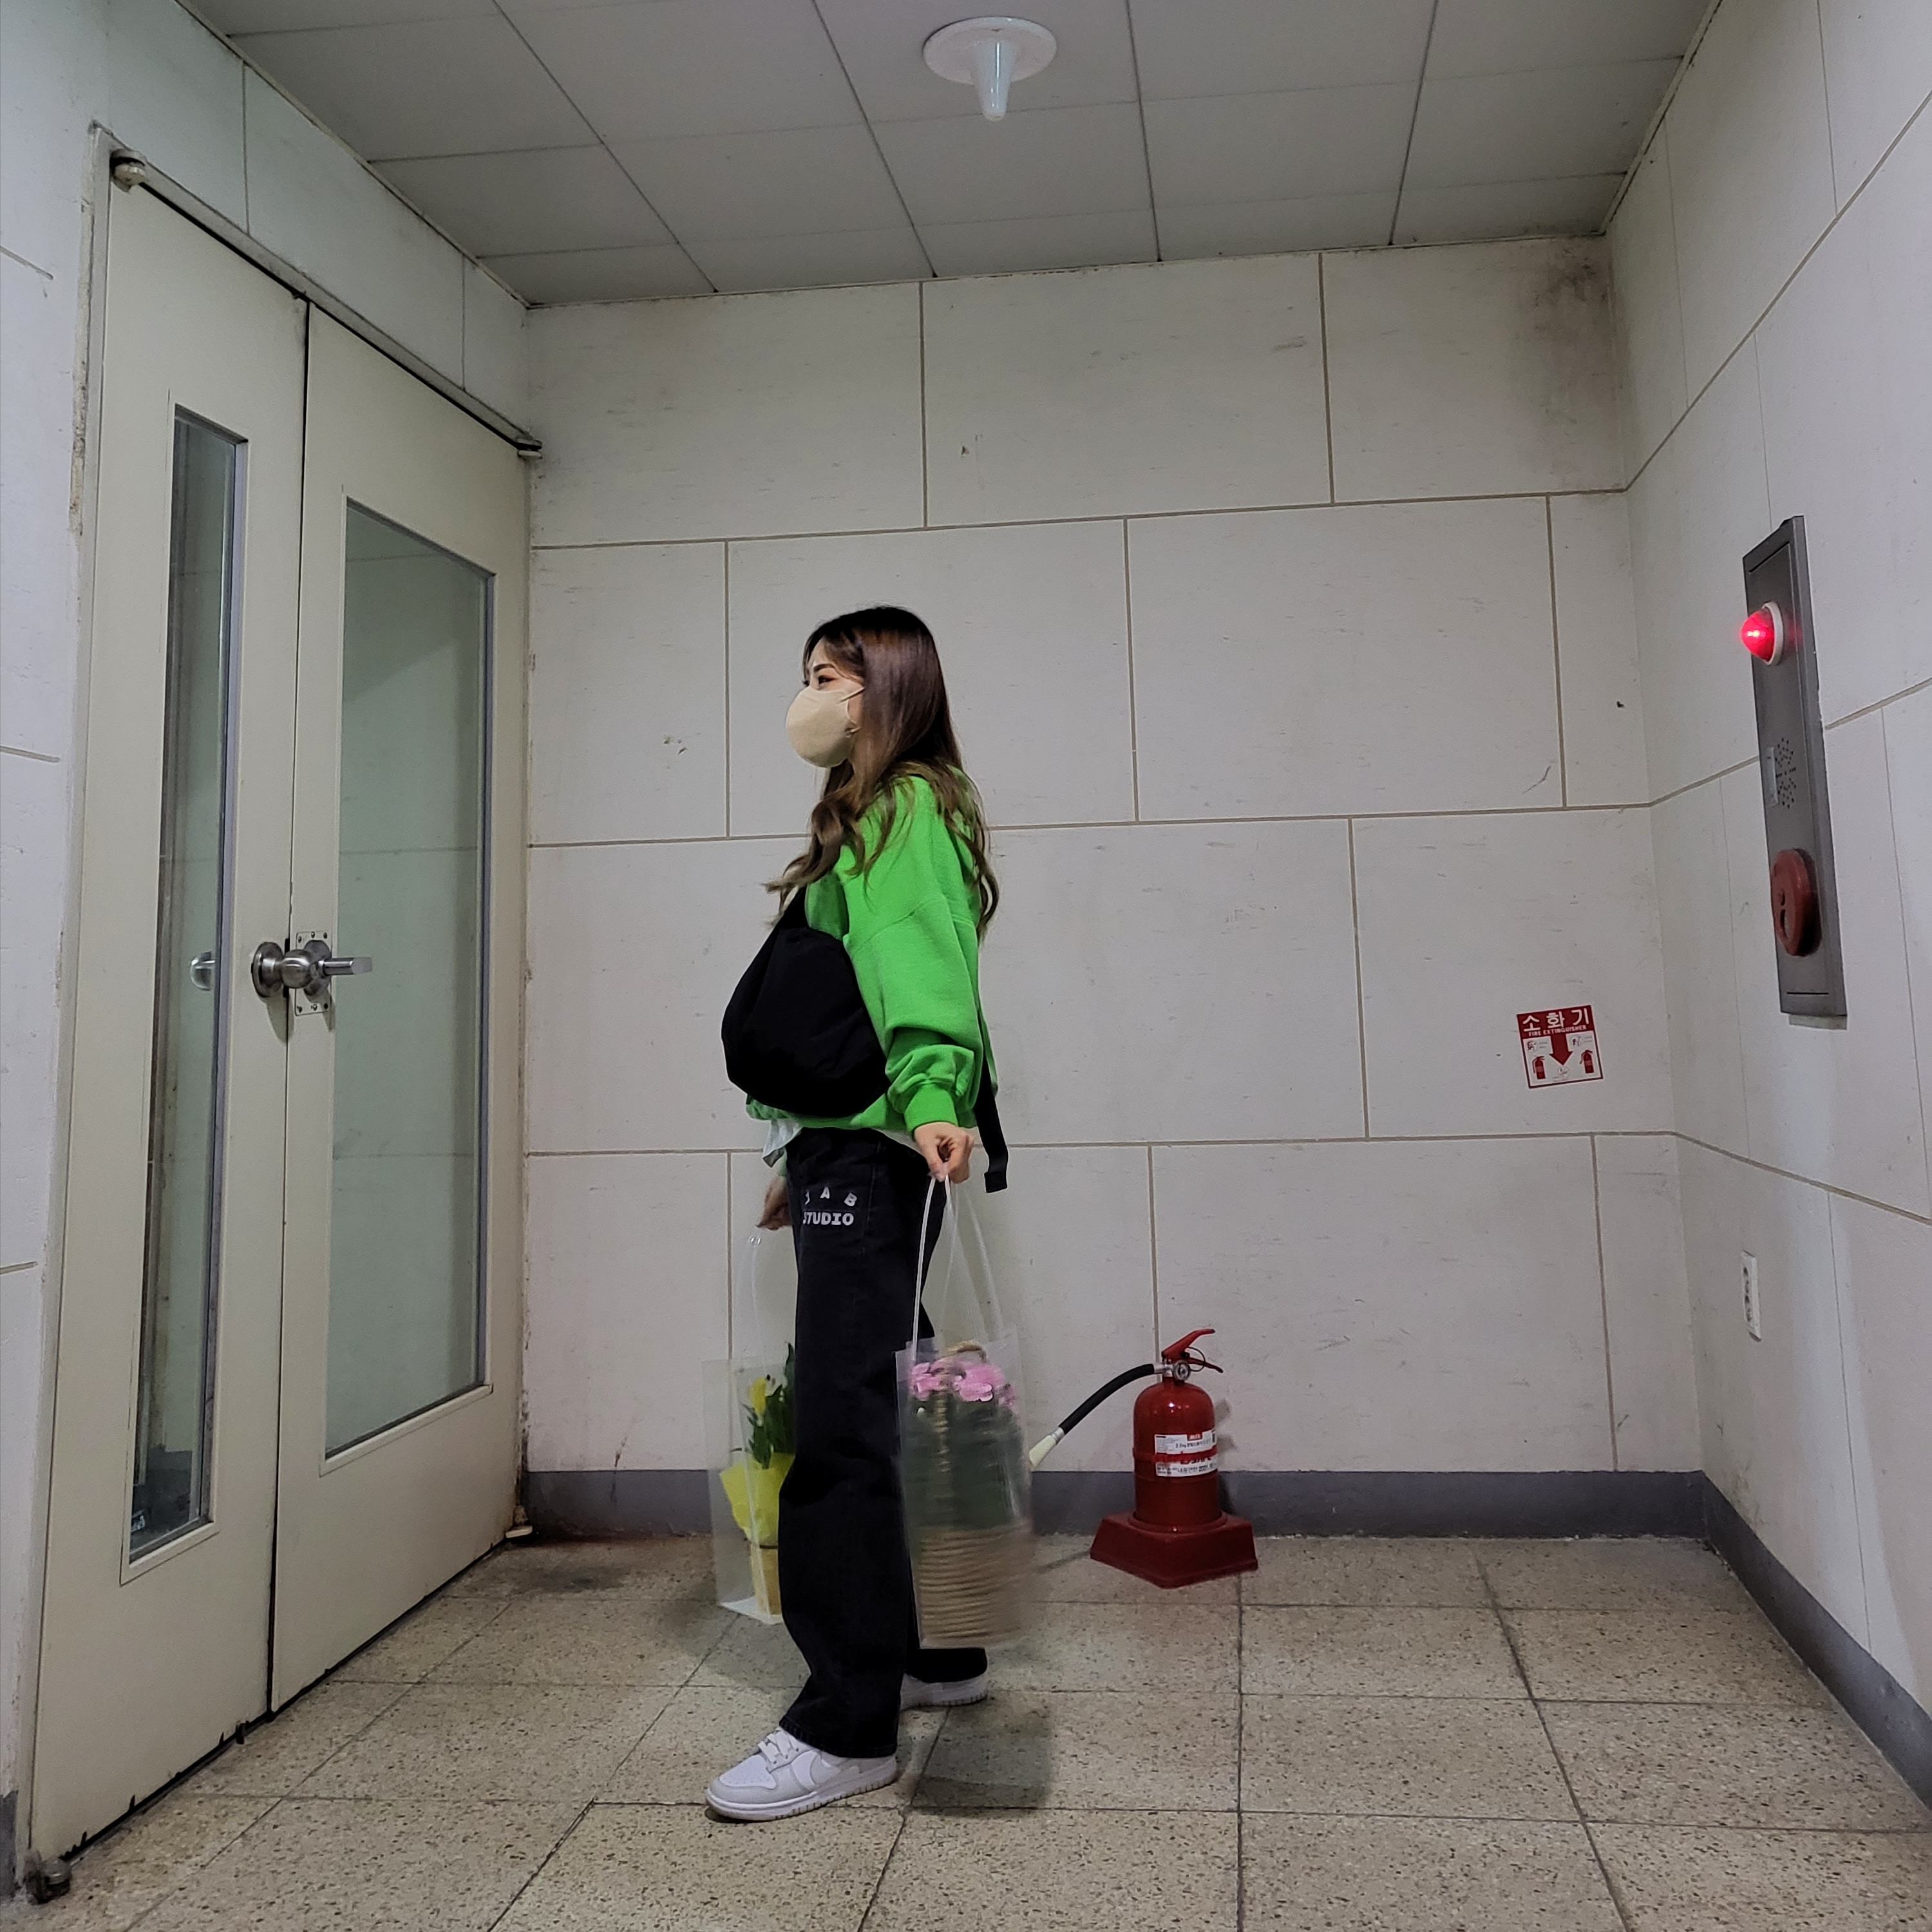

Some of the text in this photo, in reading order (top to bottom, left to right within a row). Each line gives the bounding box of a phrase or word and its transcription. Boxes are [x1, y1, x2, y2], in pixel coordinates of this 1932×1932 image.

[1522, 1008, 1589, 1032] 소화기
[1542, 1025, 1587, 1036] EXTINGUISHER
[802, 1211, 855, 1226] STUDIO
